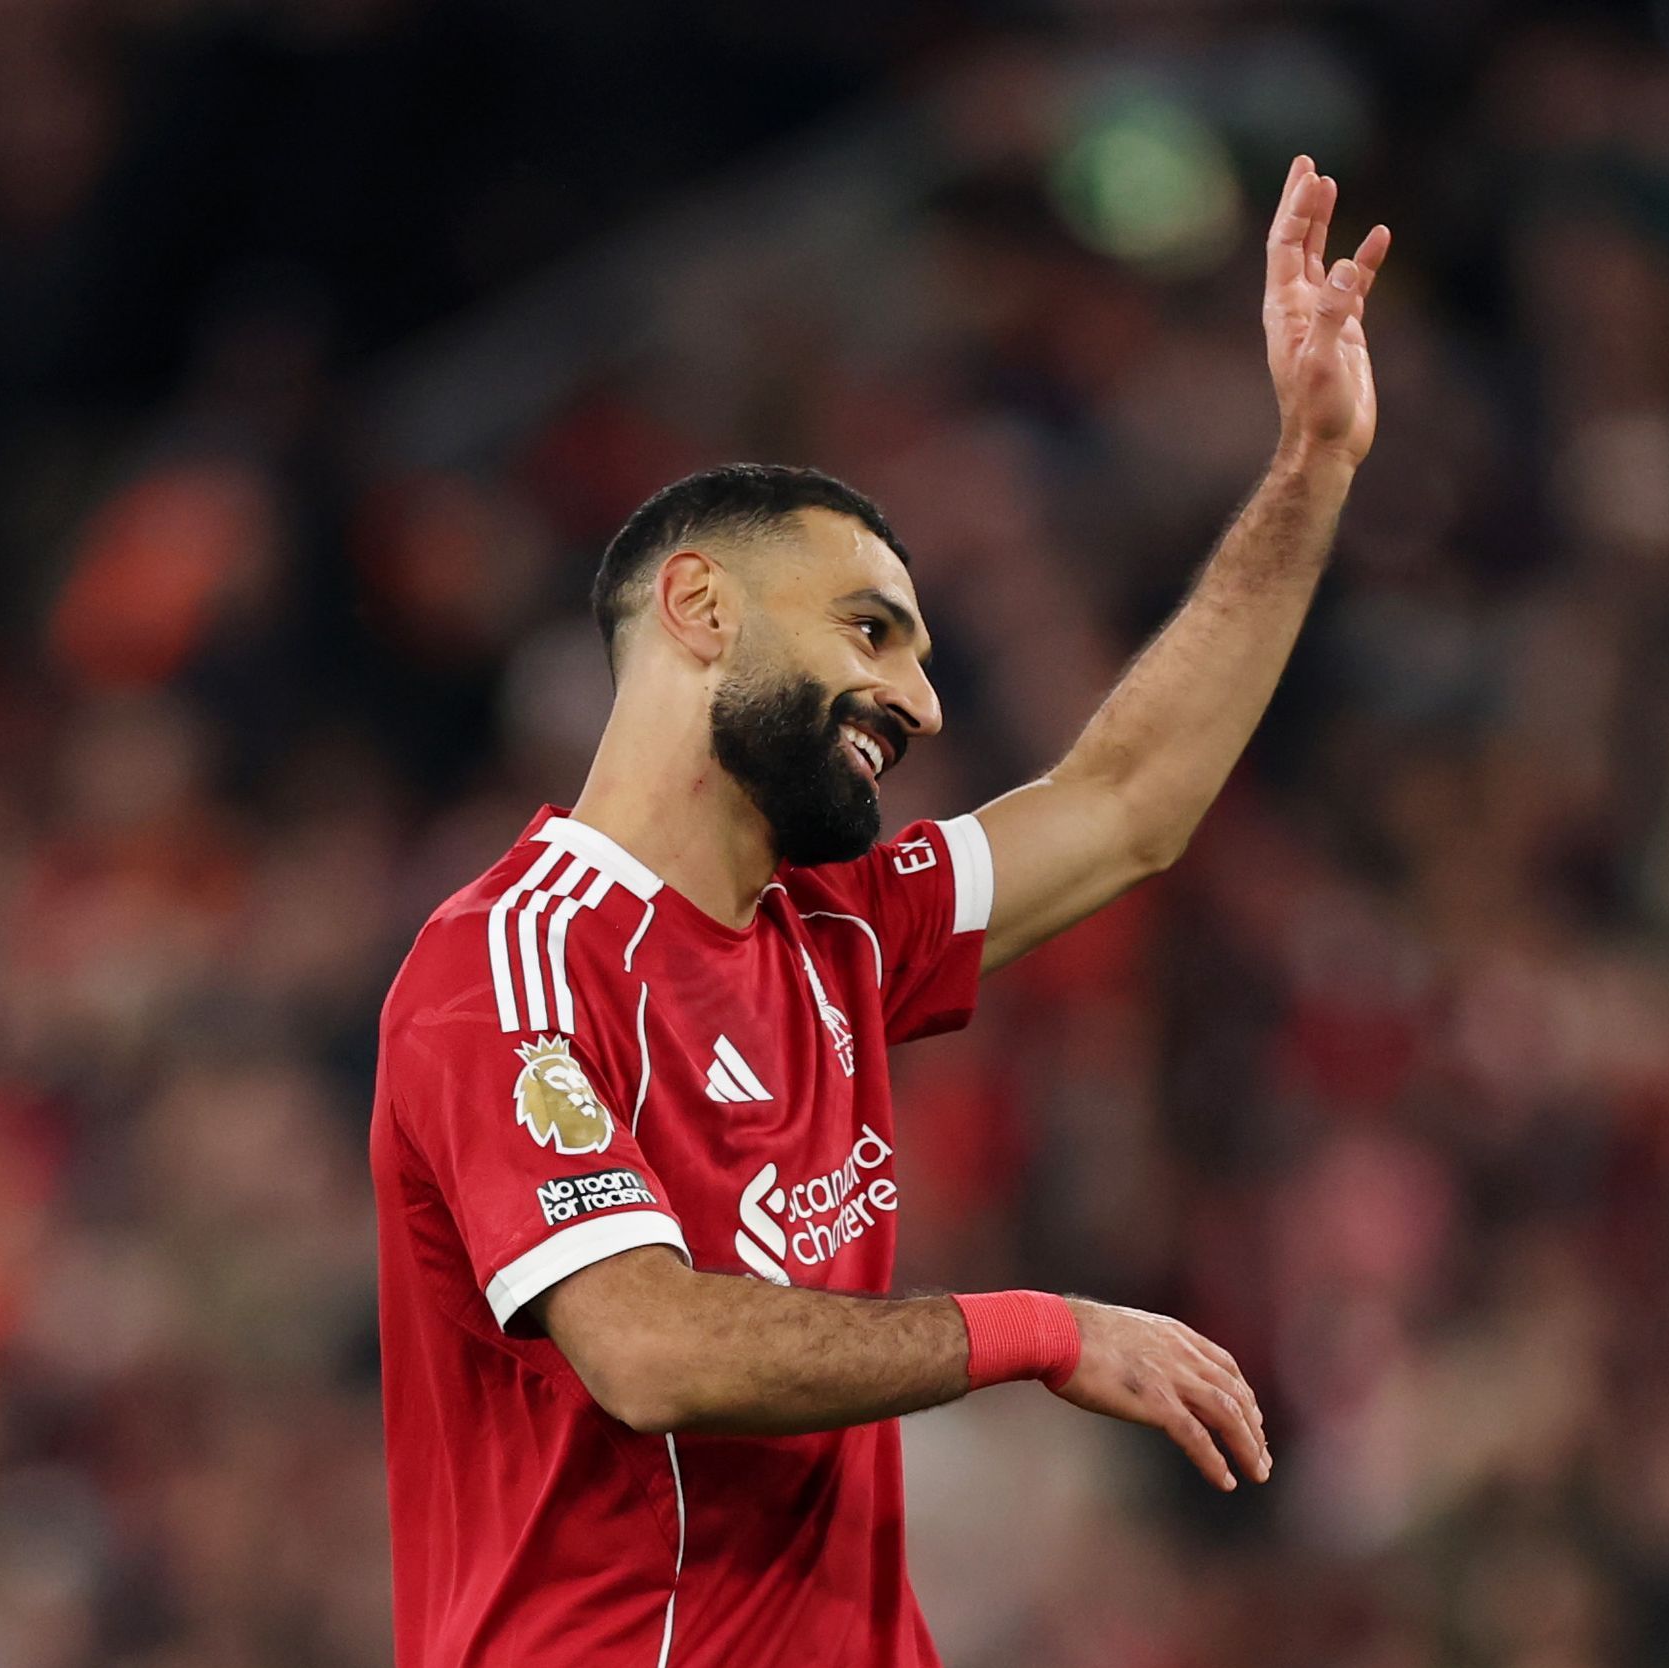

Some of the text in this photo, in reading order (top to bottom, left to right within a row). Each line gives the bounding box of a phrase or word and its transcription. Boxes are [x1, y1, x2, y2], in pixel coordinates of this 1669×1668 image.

[536, 1172, 639, 1206] No room
[581, 1188, 657, 1212] racism
